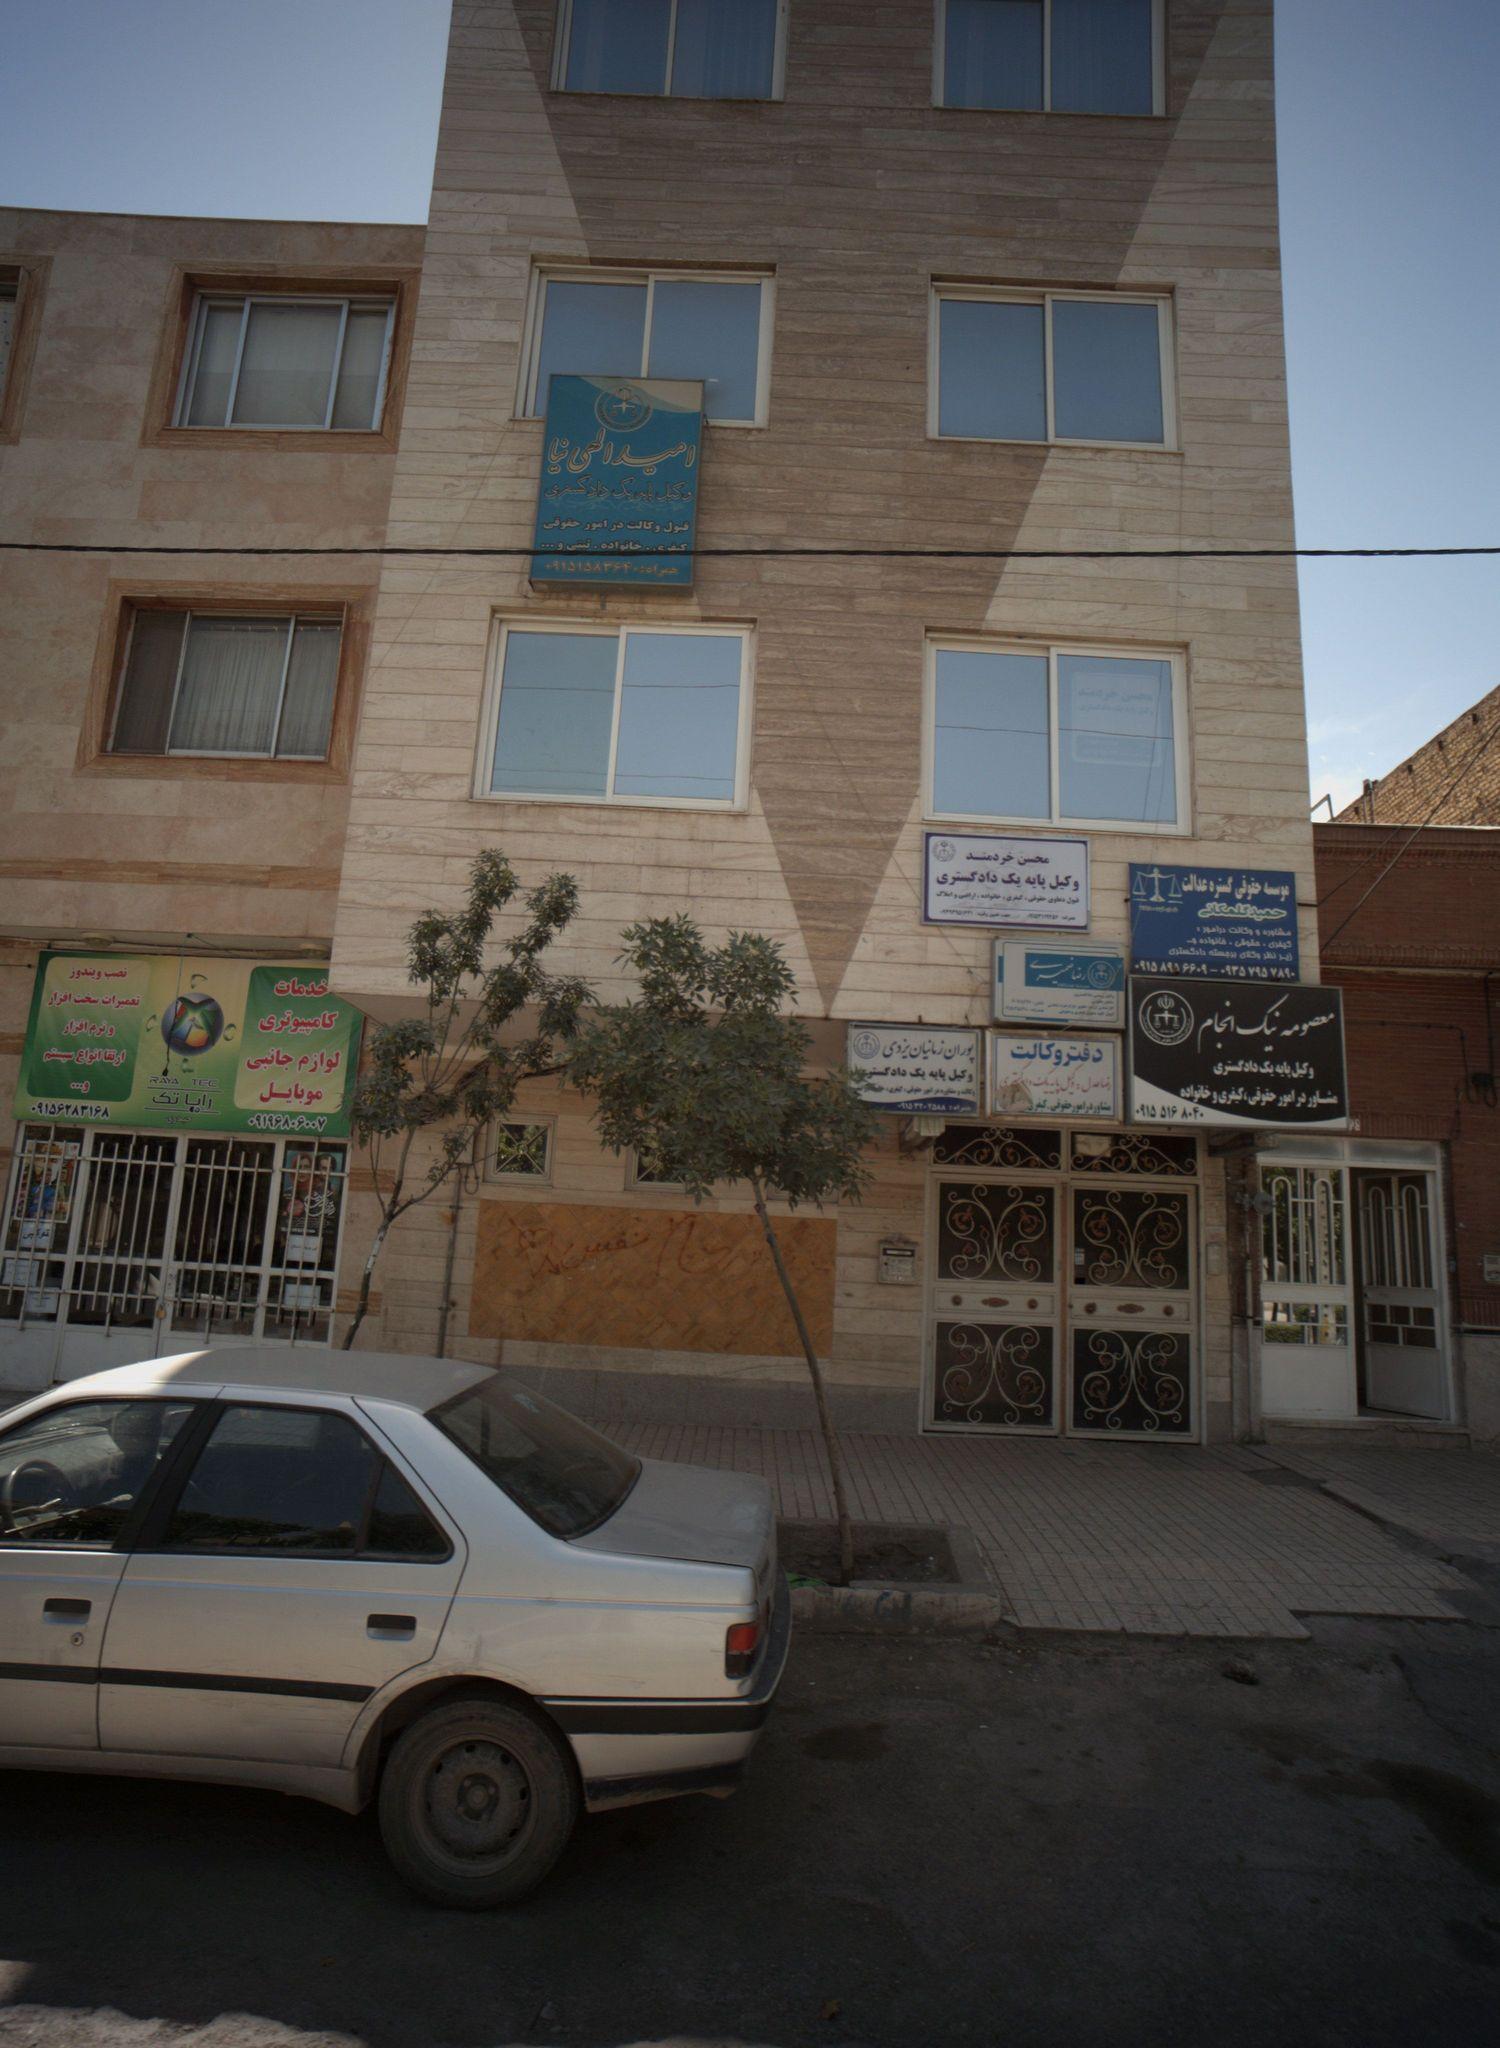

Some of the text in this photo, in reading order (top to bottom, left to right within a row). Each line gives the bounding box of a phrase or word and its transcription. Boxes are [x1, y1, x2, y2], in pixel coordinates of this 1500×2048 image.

[547, 428, 696, 475] امید الهی نیا
[544, 473, 610, 500] دادگستری
[656, 480, 694, 502] وکیل
[542, 515, 690, 534] قبول وکالت در امور حقوقی
[966, 850, 1050, 866] محسن خردمند
[936, 870, 1080, 892] وکیل پایه یک دادگستری
[1181, 873, 1290, 902] موسسه حقوقی گستره عدالت
[936, 889, 953, 898] املاک
[958, 891, 977, 900] اراضی
[981, 892, 1001, 901] خانواده
[1006, 894, 1023, 902] کیفری
[1027, 894, 1047, 902] حقوقی
[1047, 895, 1066, 904] دعاوی
[1066, 896, 1080, 904] قبول
[1228, 926, 1254, 936] وکالت
[1262, 928, 1292, 937] مشاوره
[1199, 937, 1227, 946] خانواده
[1234, 938, 1262, 948] حقوقی
[1267, 940, 1293, 949] کیفری
[1168, 946, 1293, 962] زیر نظر وکلای برجسته دادگستری
[69, 967, 128, 980] نصب ویندوز
[1070, 966, 1086, 981] رضا
[1134, 960, 1157, 973] ۰۹۱۵
[1182, 962, 1209, 975] ۶۶۰۹
[1220, 964, 1247, 977] ۰۹۳۵
[1248, 965, 1268, 978] ۷۹۵
[1270, 967, 1296, 979] ۷۸۹۰
[273, 977, 329, 998] خدمات
[47, 990, 142, 1009] تعمیرات سخت افزار
[62, 1018, 117, 1036] و نرم افزار
[258, 1009, 340, 1036] کامپیوتری
[1196, 999, 1236, 1055] انجام
[1234, 992, 1290, 1053] نیک
[1278, 1010, 1336, 1038] معصومه
[43, 1046, 126, 1068] ارتقا انواع سیستم
[882, 1038, 910, 1060] یزدی
[943, 1043, 976, 1064] پوران
[1010, 1041, 1104, 1067] دفتر وکالت
[245, 1048, 341, 1074] لوازم جانبی
[1212, 1058, 1314, 1080] وکیل پایه یک دادگستری
[149, 1076, 180, 1086] RAYA
[868, 1066, 973, 1083] وکیل پایه یک دادگستر
[258, 1080, 324, 1106] موبایل
[1178, 1083, 1211, 1103] خانواده
[1211, 1091, 1218, 1104] و
[1276, 1089, 1296, 1107] امور
[1296, 1091, 1307, 1107] در
[1306, 1089, 1339, 1108] مشاور
[152, 1091, 213, 1114] رایا تک
[1049, 1098, 1072, 1112] حقوقی
[1135, 1103, 1157, 1118] ۰۹۱۵
[1160, 1105, 1178, 1119] ۵۱۶
[247, 1112, 328, 1132] ۰۹۱۹۶۸۰۶۰۰۷
